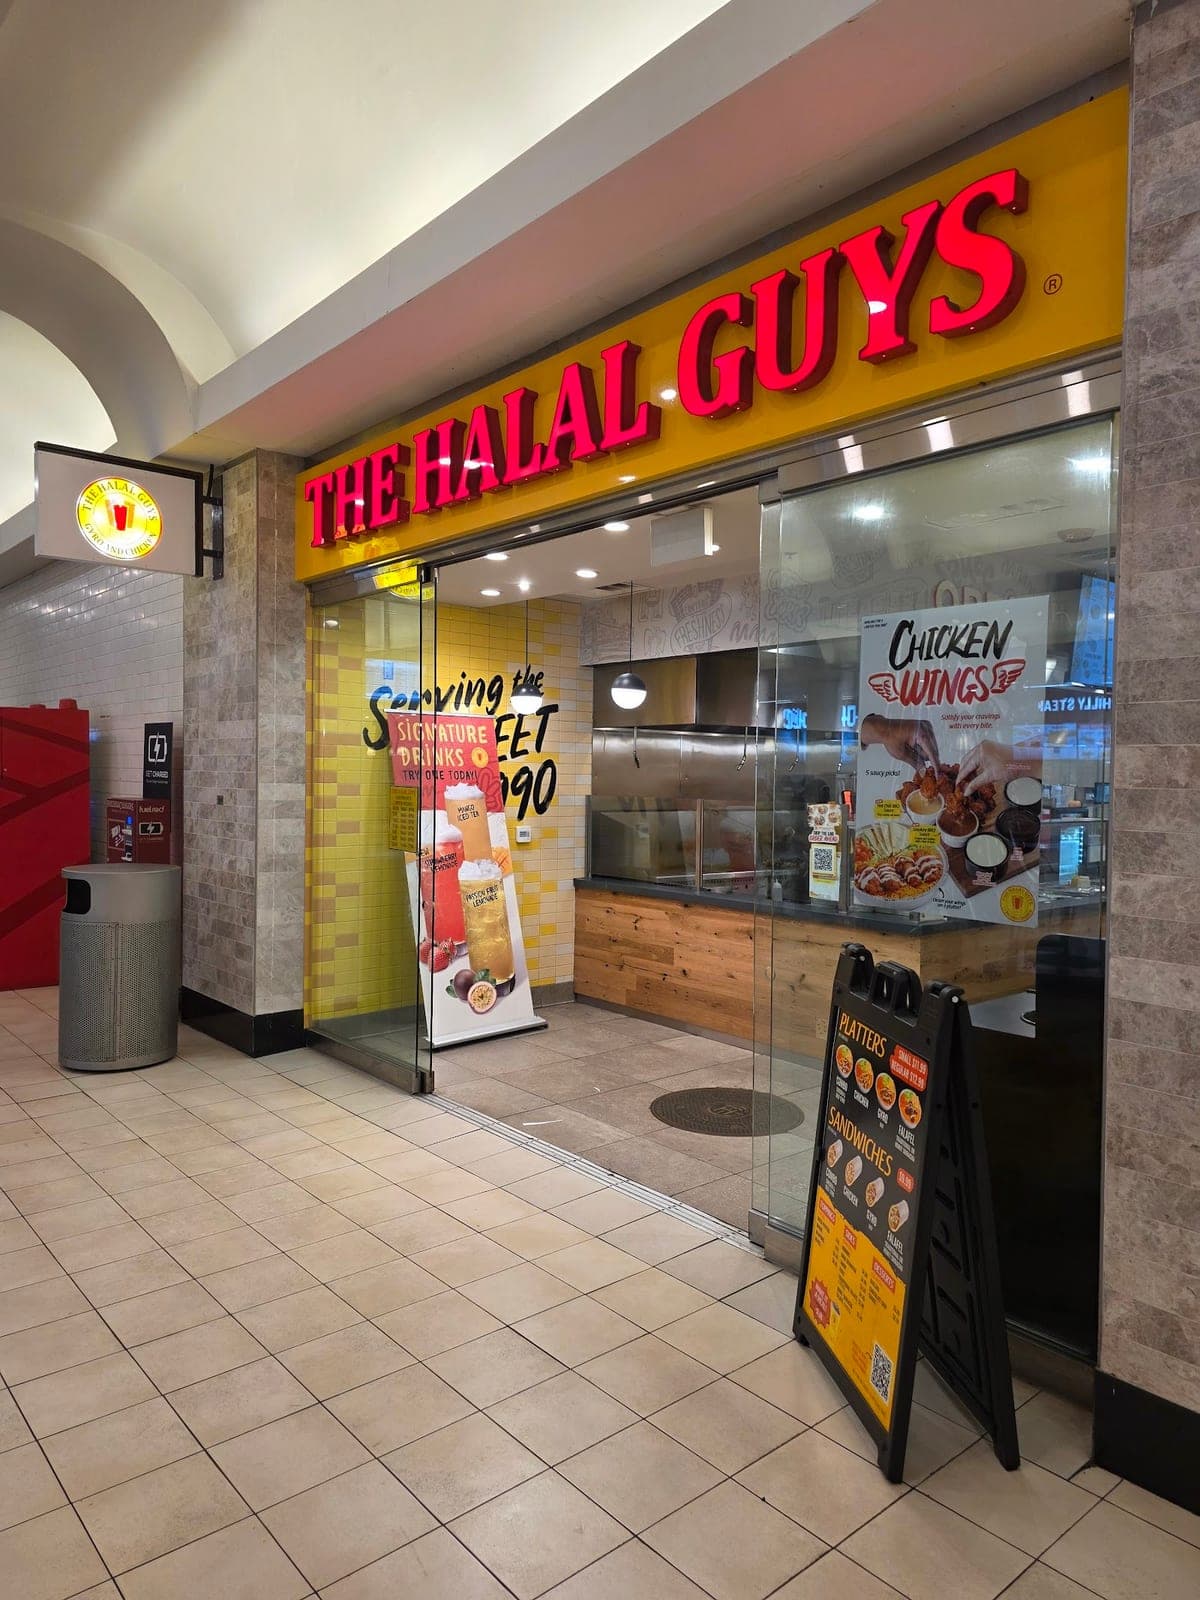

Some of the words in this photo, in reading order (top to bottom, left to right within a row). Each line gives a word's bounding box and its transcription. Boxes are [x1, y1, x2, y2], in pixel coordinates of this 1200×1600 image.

[304, 442, 410, 548] THE
[412, 340, 661, 515] HALAL
[677, 168, 1028, 419] GUYS
[82, 489, 98, 511] THE
[97, 480, 135, 496] HALAL
[137, 492, 158, 521] GUYS
[84, 522, 105, 545] GYRO
[889, 620, 1013, 671] CHICKEN
[899, 664, 990, 707] WINGS
[362, 671, 503, 749] Serving
[397, 719, 488, 744] SIGNATURE
[400, 744, 465, 768] DRINKS
[403, 770, 420, 780] TRY
[425, 769, 445, 781] ONE
[448, 769, 478, 780] TODAY!
[458, 813, 470, 822] ICED
[839, 1012, 887, 1058] PLATTERS
[899, 1049, 912, 1066] SMALL
[853, 1089, 870, 1109] CHICKEN
[828, 1106, 893, 1177] SANDWICHES
[898, 1124, 915, 1146] FALAFEL
[843, 1185, 858, 1207] CHICKEN
[886, 1230, 904, 1255] FALAFEL
